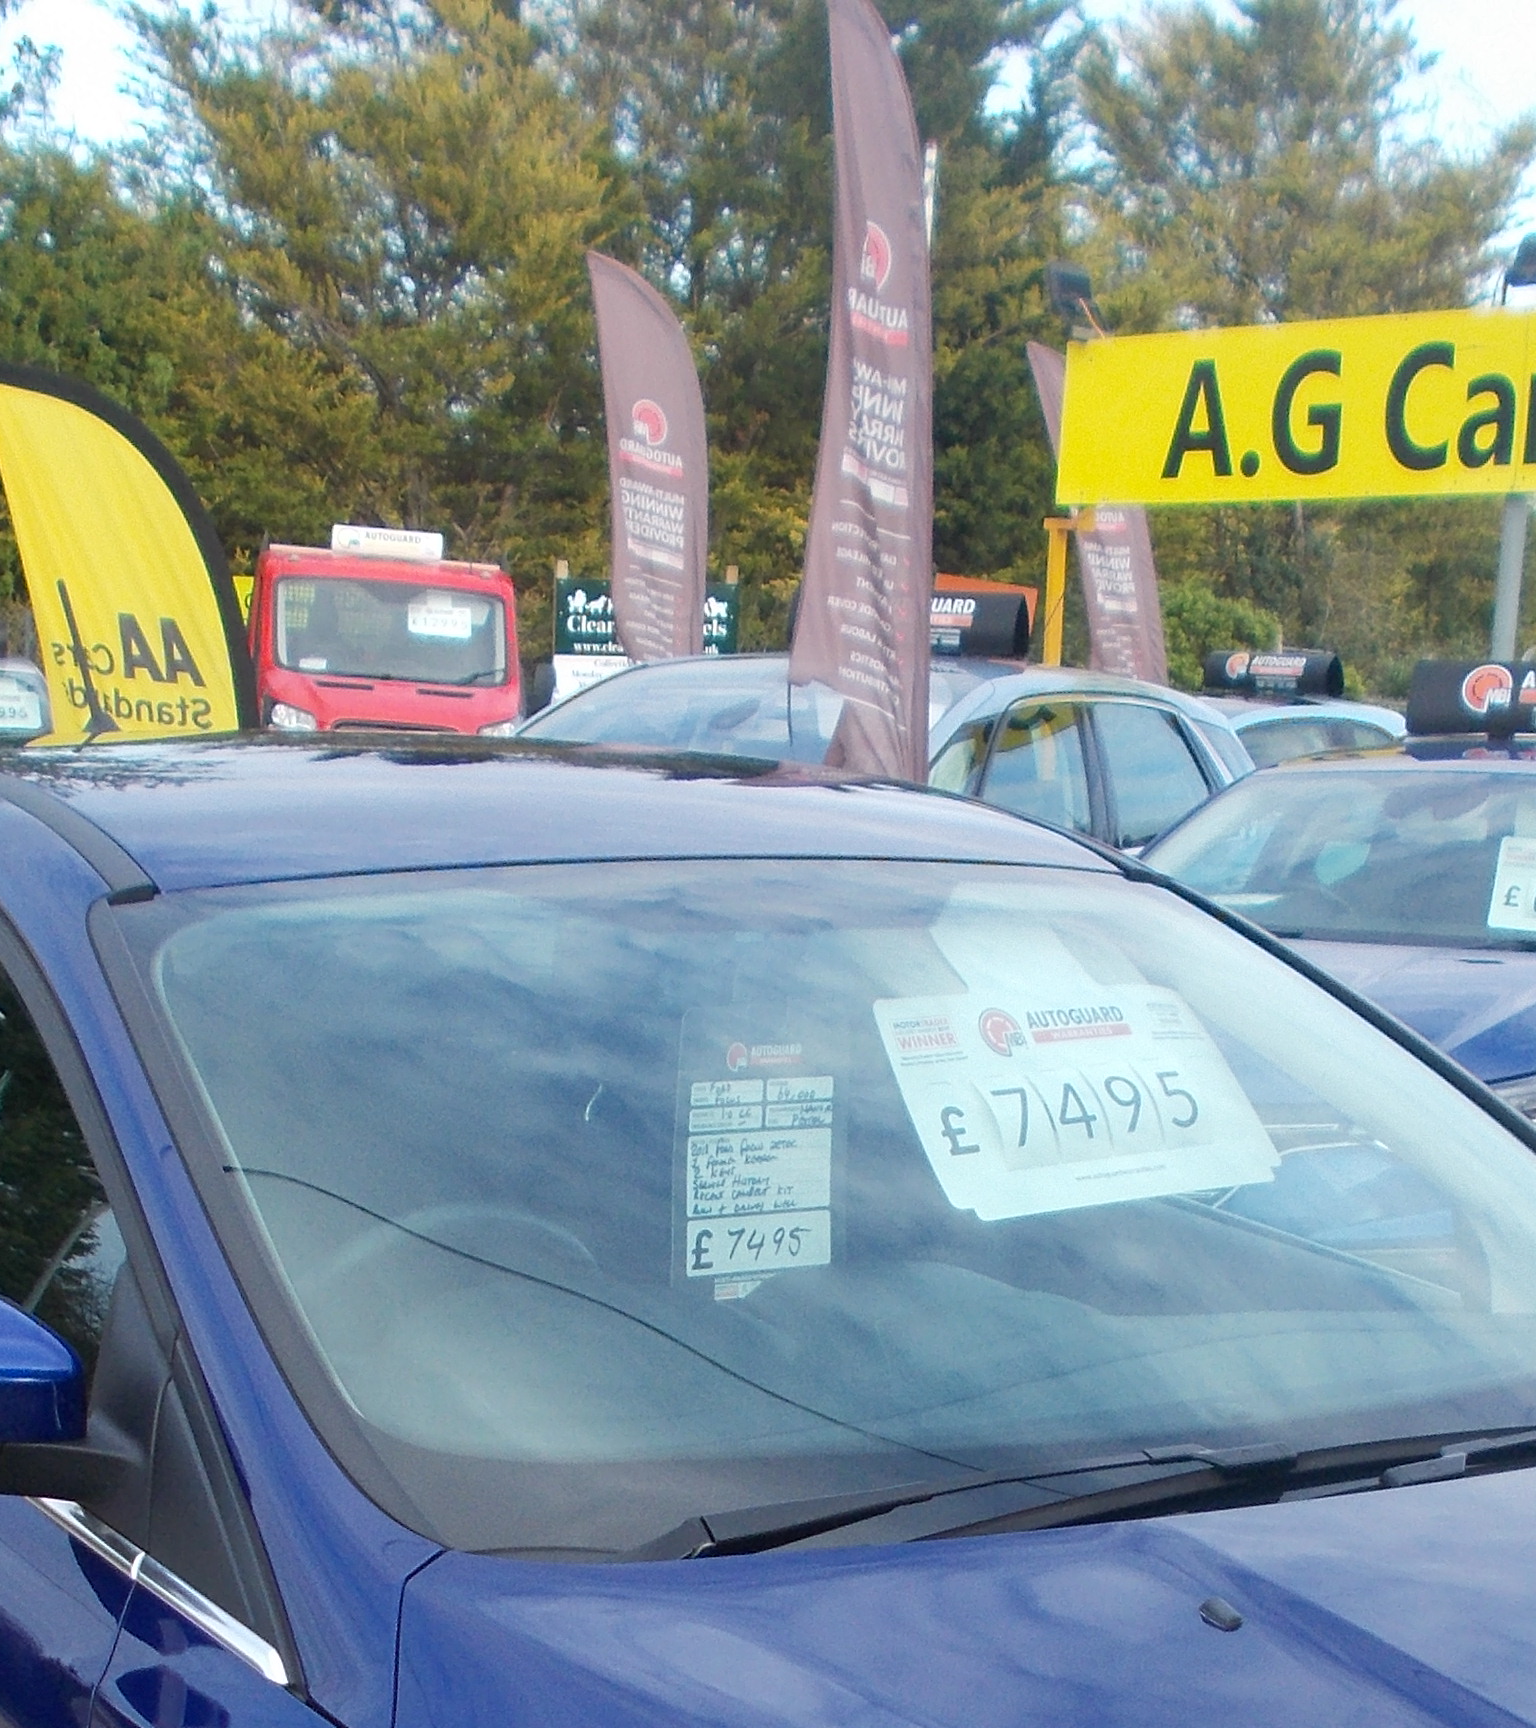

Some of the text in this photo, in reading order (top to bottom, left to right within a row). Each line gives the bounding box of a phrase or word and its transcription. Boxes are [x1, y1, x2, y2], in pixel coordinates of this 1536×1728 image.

[1161, 348, 1344, 478] A.G
[364, 531, 422, 544] AUTOGUARD
[1252, 655, 1307, 668] AUTOGUARD
[1487, 687, 1512, 705] MBI
[1025, 1005, 1125, 1031] AUTOGUARD
[896, 1031, 958, 1050] WINNER
[1004, 1031, 1028, 1049] MBI
[1050, 1024, 1115, 1040] WARRANTIES
[750, 1043, 803, 1056] AUTOGUARD
